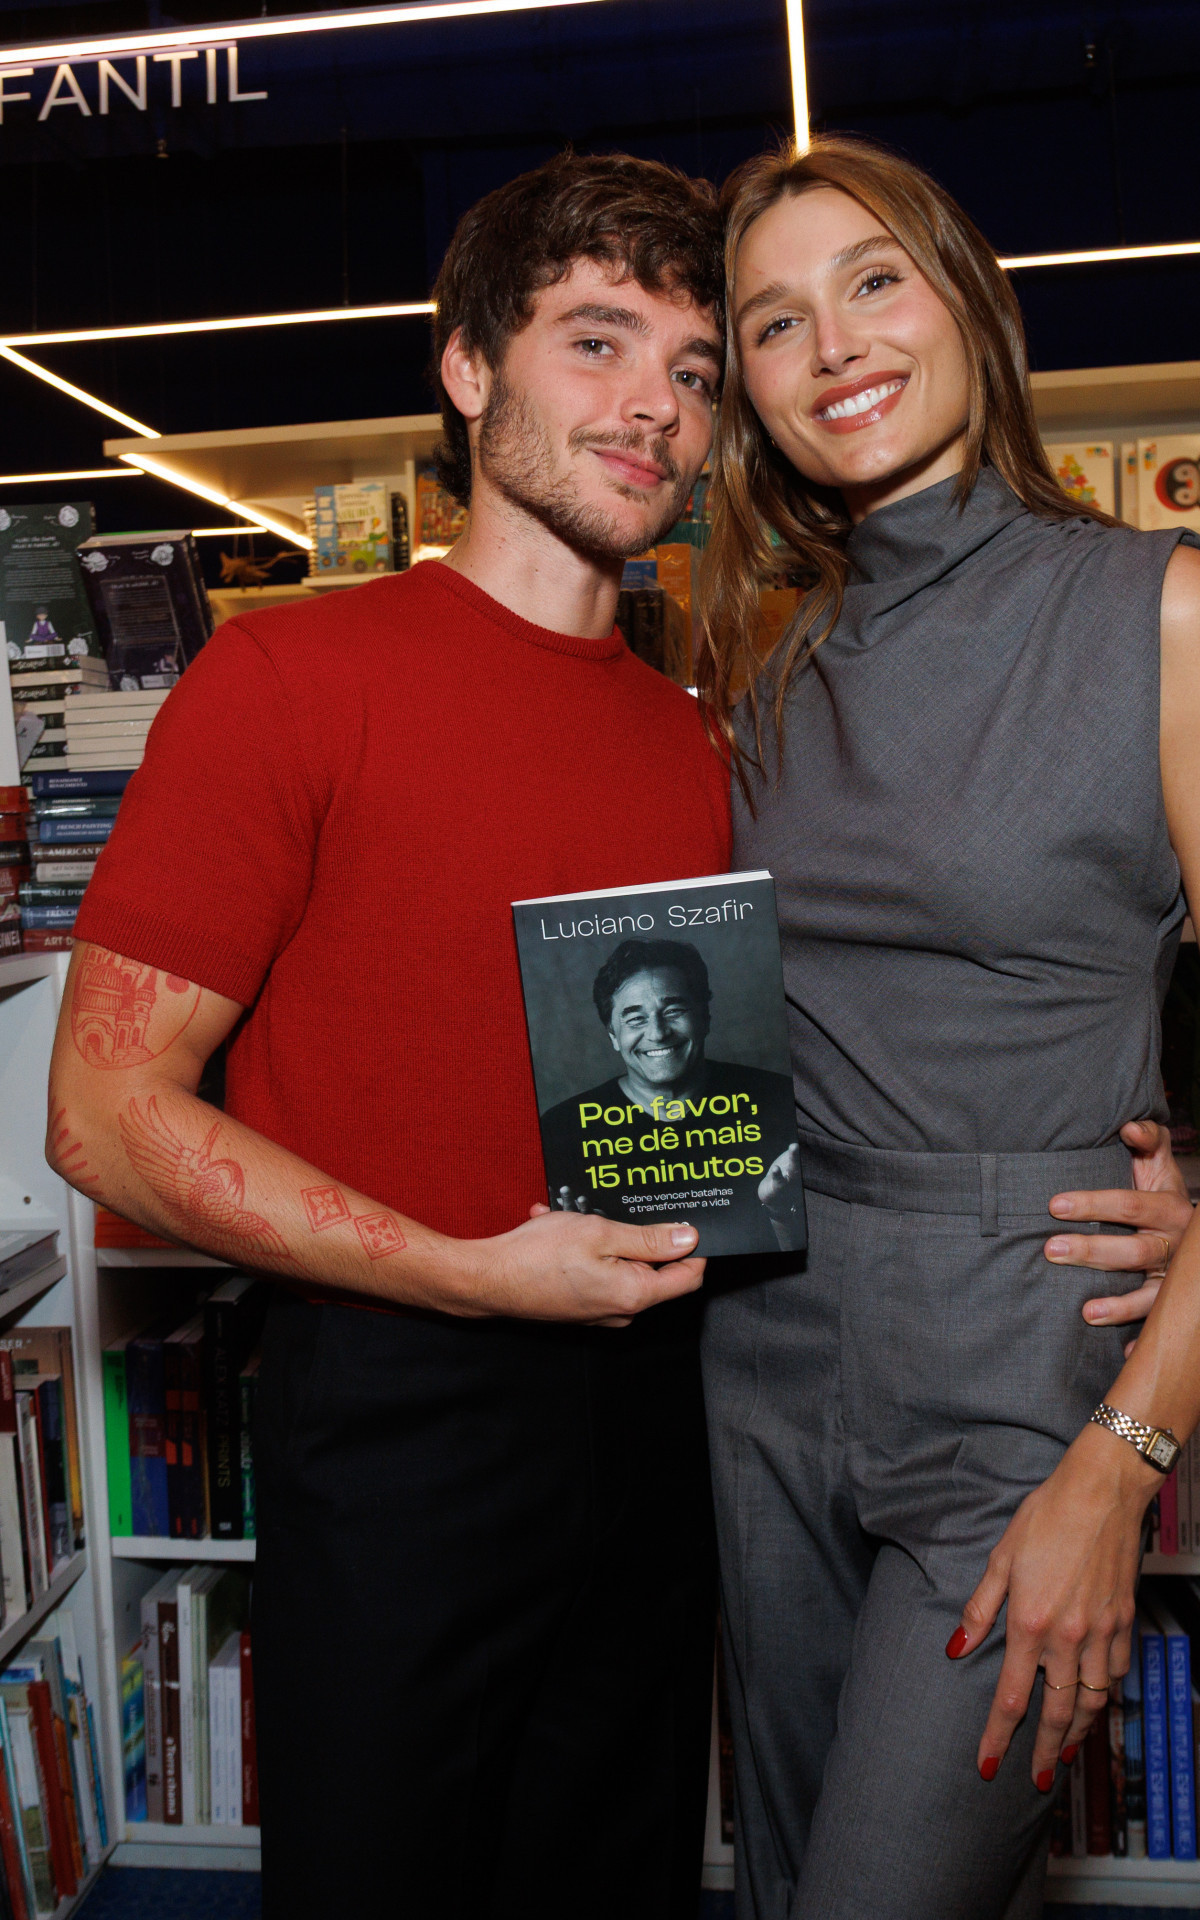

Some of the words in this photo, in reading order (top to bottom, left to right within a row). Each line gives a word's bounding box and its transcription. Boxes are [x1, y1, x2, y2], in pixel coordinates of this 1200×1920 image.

[0, 46, 268, 125] FANTIL
[49, 848, 94, 856] AMERICAN
[540, 914, 654, 940] Luciano
[668, 899, 753, 927] Szafir
[44, 936, 63, 946] ART
[579, 1101, 644, 1128] Por
[649, 1092, 758, 1122] favor,
[582, 1135, 633, 1157] me
[639, 1126, 680, 1152] dê
[685, 1120, 762, 1148] mais
[585, 1164, 621, 1189] 15
[627, 1156, 764, 1186] minutos
[621, 1194, 653, 1204] Sobre
[654, 1191, 690, 1201] vencer
[690, 1187, 734, 1198] batalhas
[637, 1199, 700, 1212] transformar
[708, 1198, 730, 1206] vida
[216, 1433, 231, 1488] PRINTS
